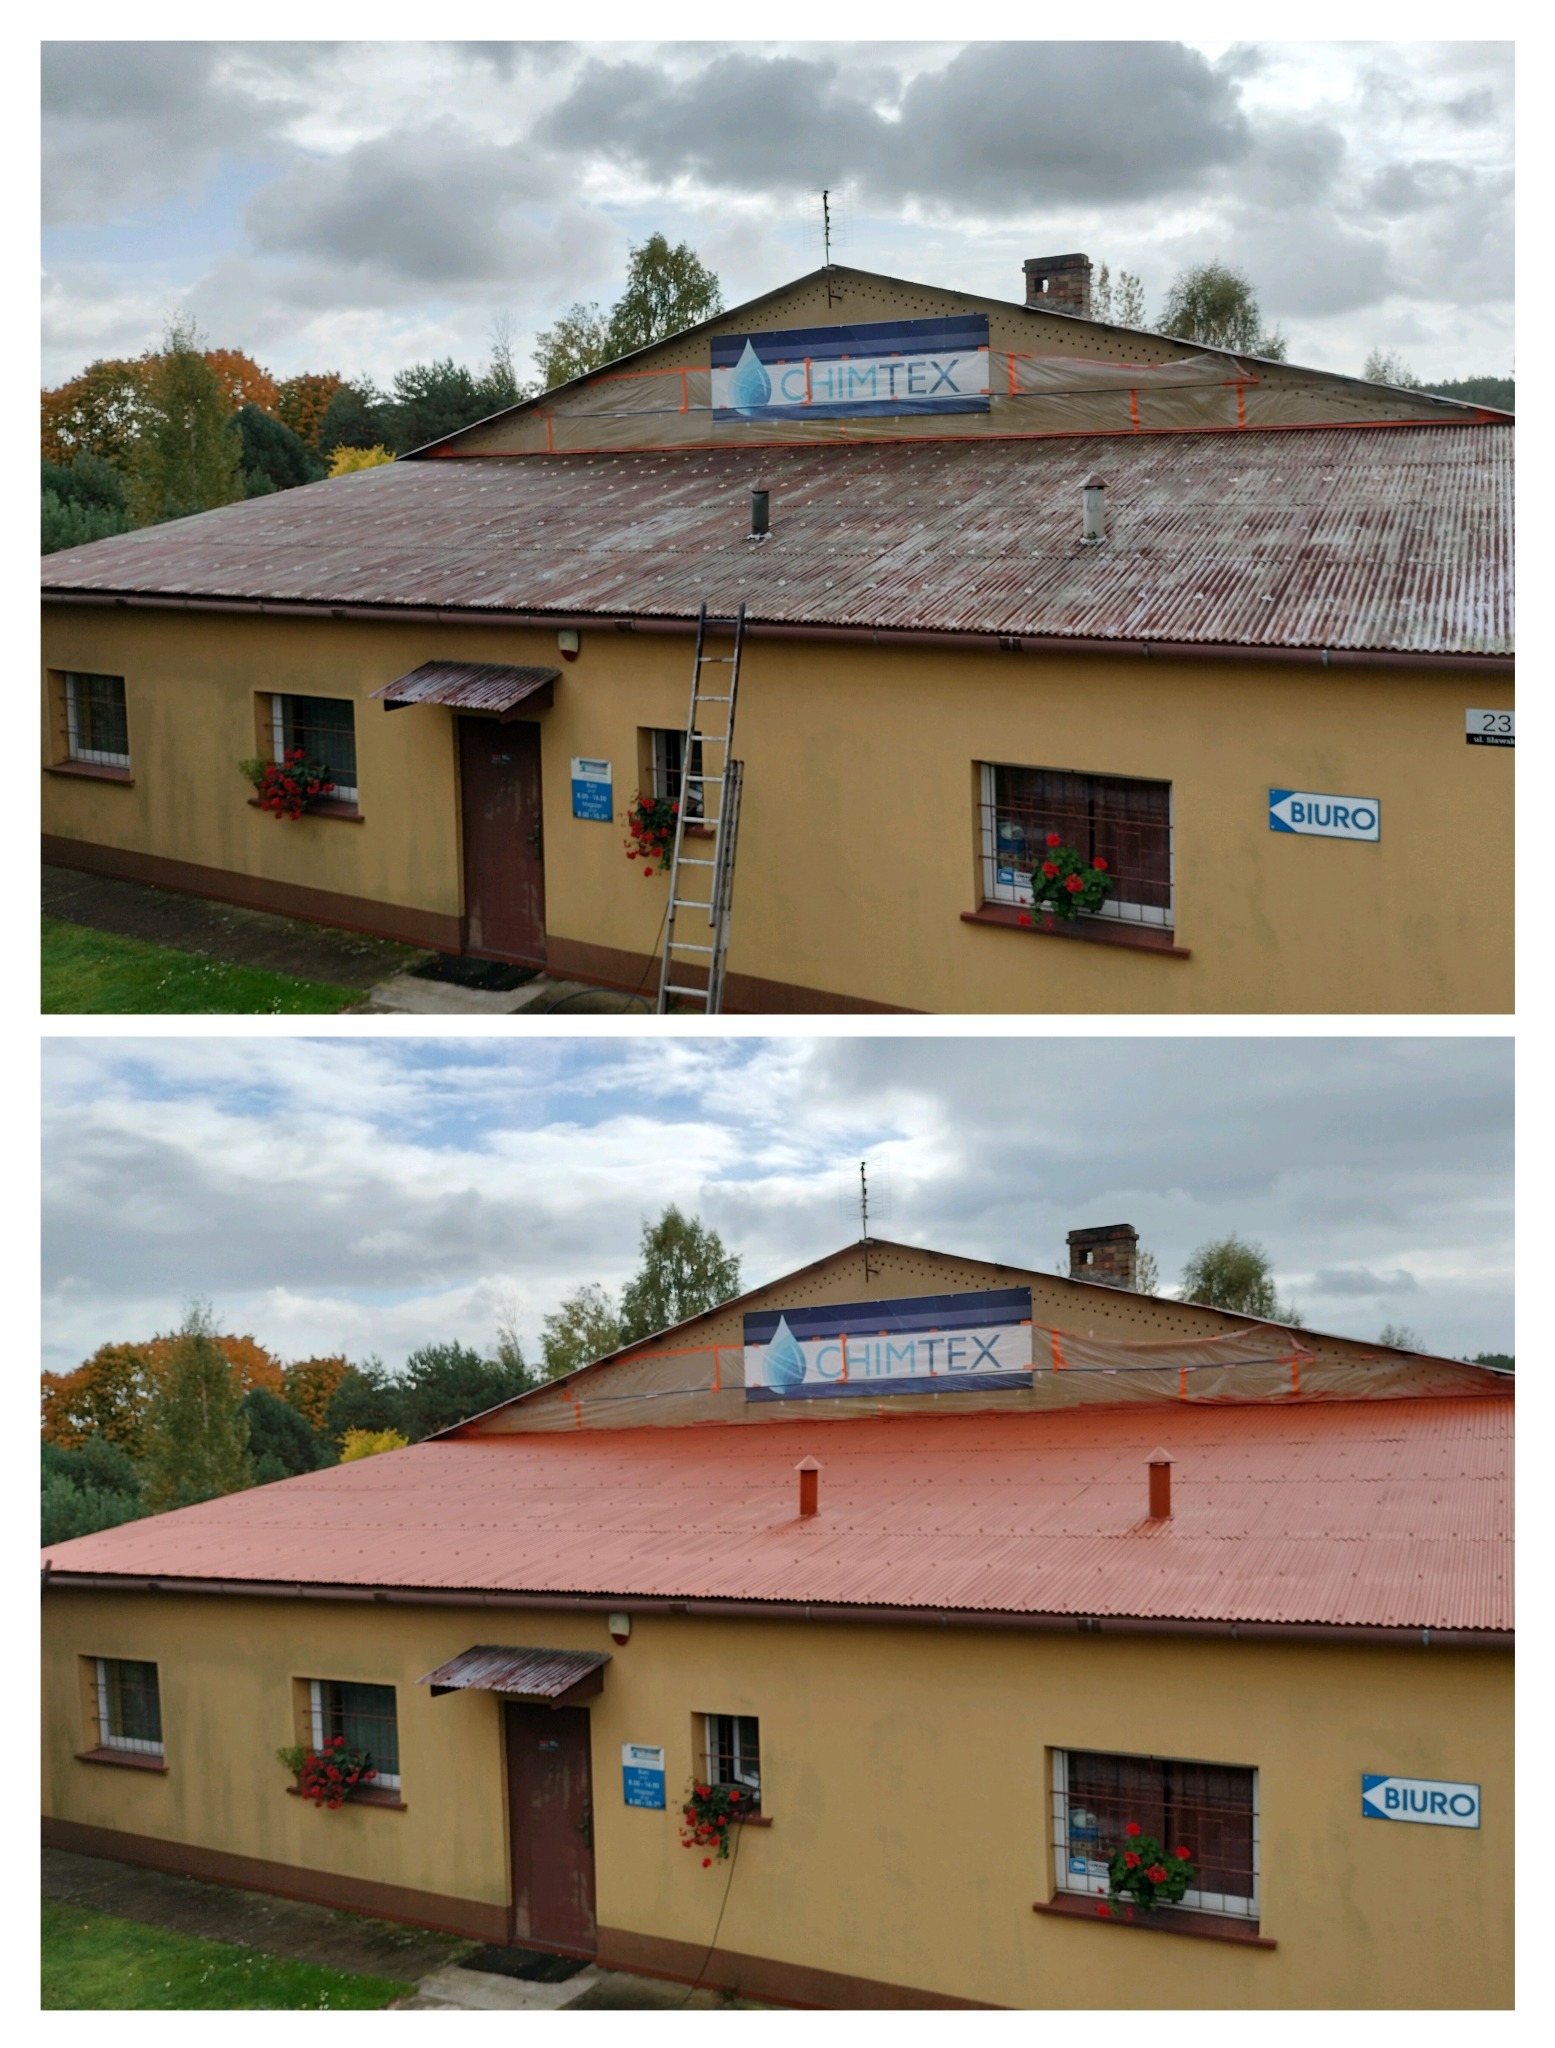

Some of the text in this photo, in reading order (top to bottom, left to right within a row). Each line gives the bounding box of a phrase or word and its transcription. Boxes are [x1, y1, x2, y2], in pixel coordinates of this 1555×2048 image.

[781, 359, 961, 401] CHIMTEX
[1482, 713, 1512, 733] 23
[1290, 801, 1376, 830] BIURO
[816, 1333, 1002, 1379] CHIMTEX
[1384, 1787, 1476, 1817] BIURO
